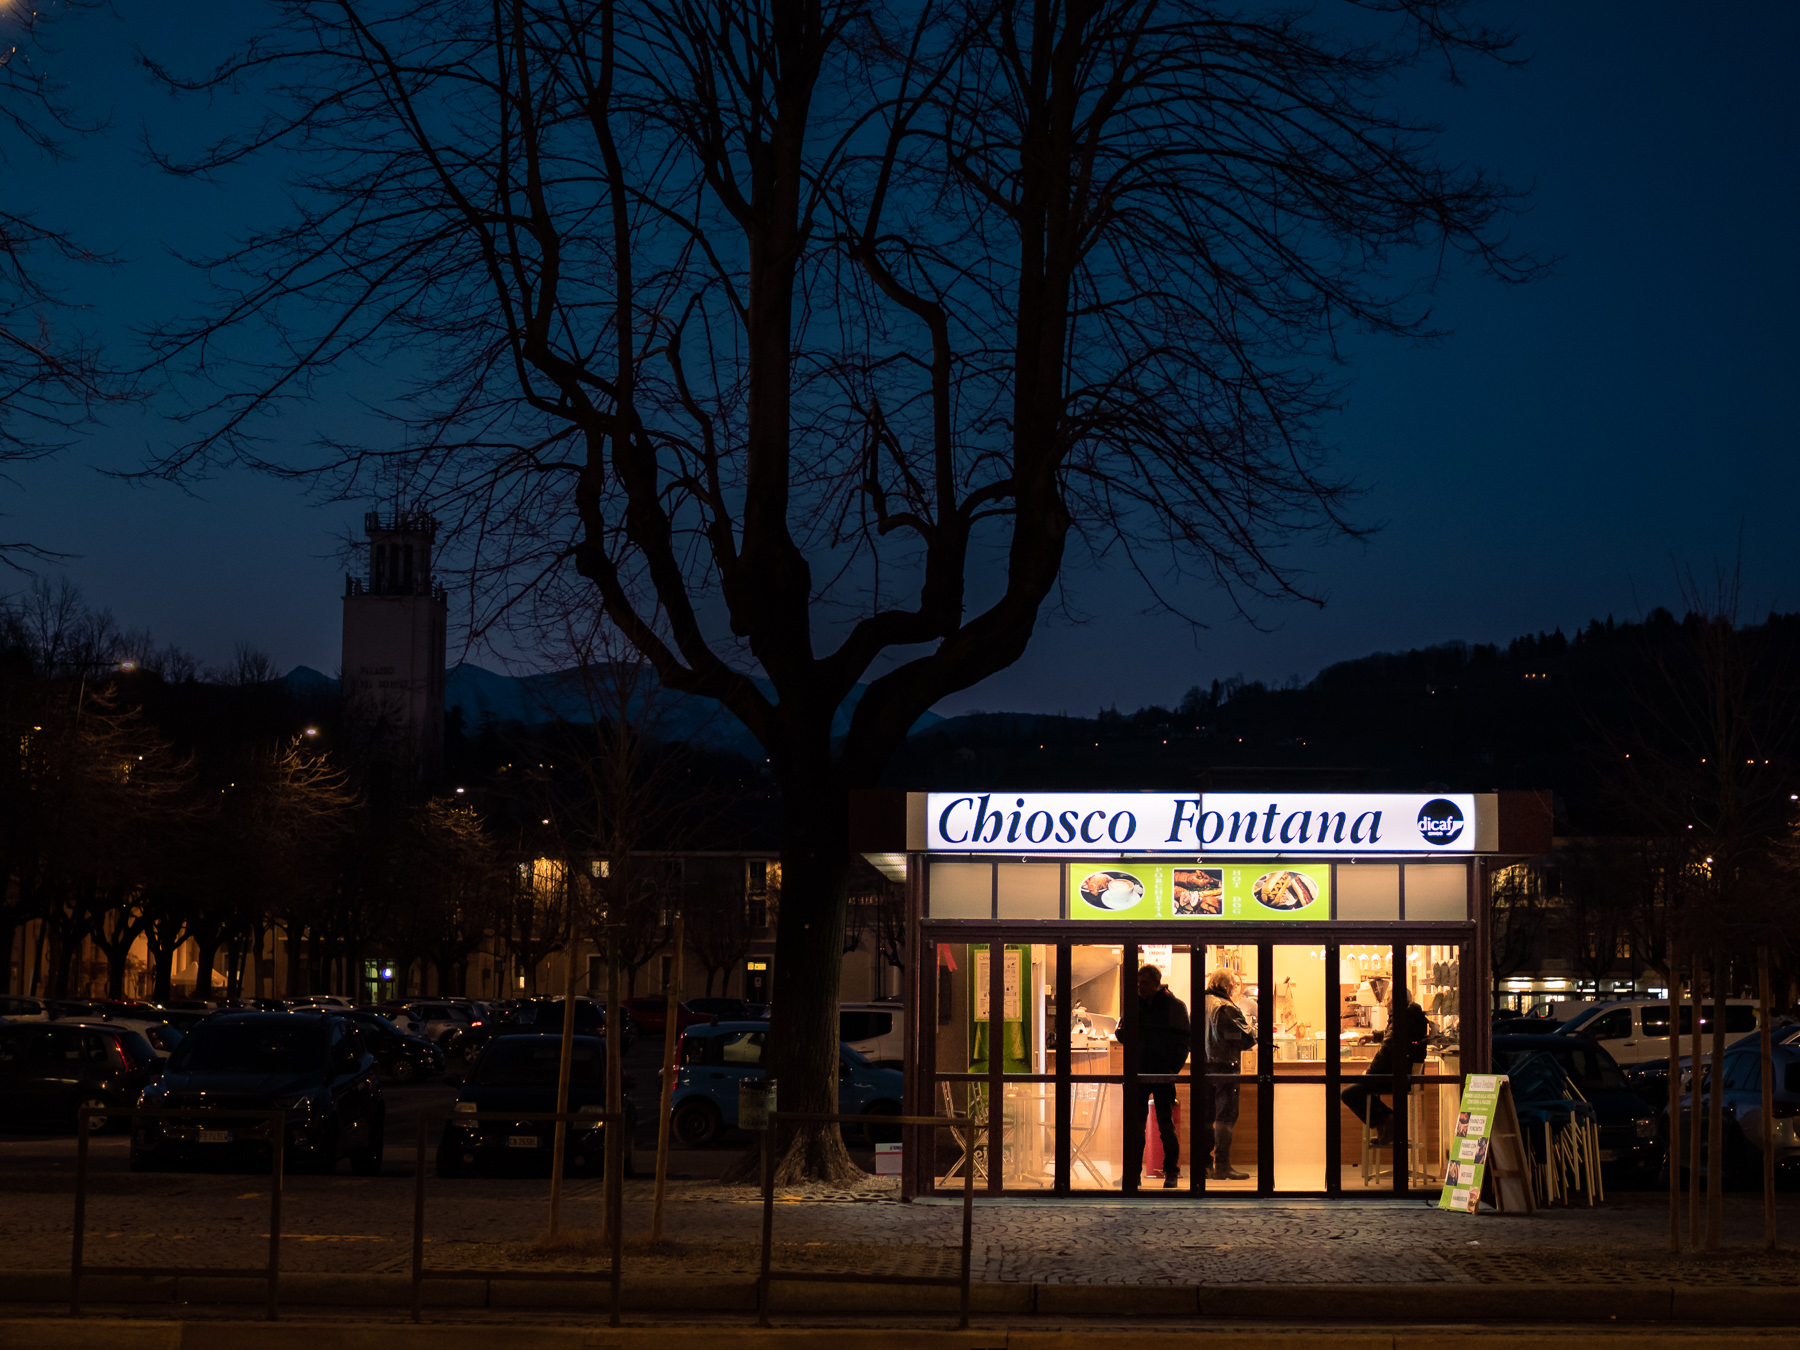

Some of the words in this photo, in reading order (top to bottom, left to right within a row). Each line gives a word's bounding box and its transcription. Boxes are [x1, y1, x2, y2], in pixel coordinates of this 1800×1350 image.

[938, 793, 1137, 844] Chiosco
[1164, 799, 1383, 844] Fontana
[1154, 867, 1163, 917] PORCHETTA
[1232, 870, 1241, 888] HOT
[1232, 896, 1241, 914] DOG
